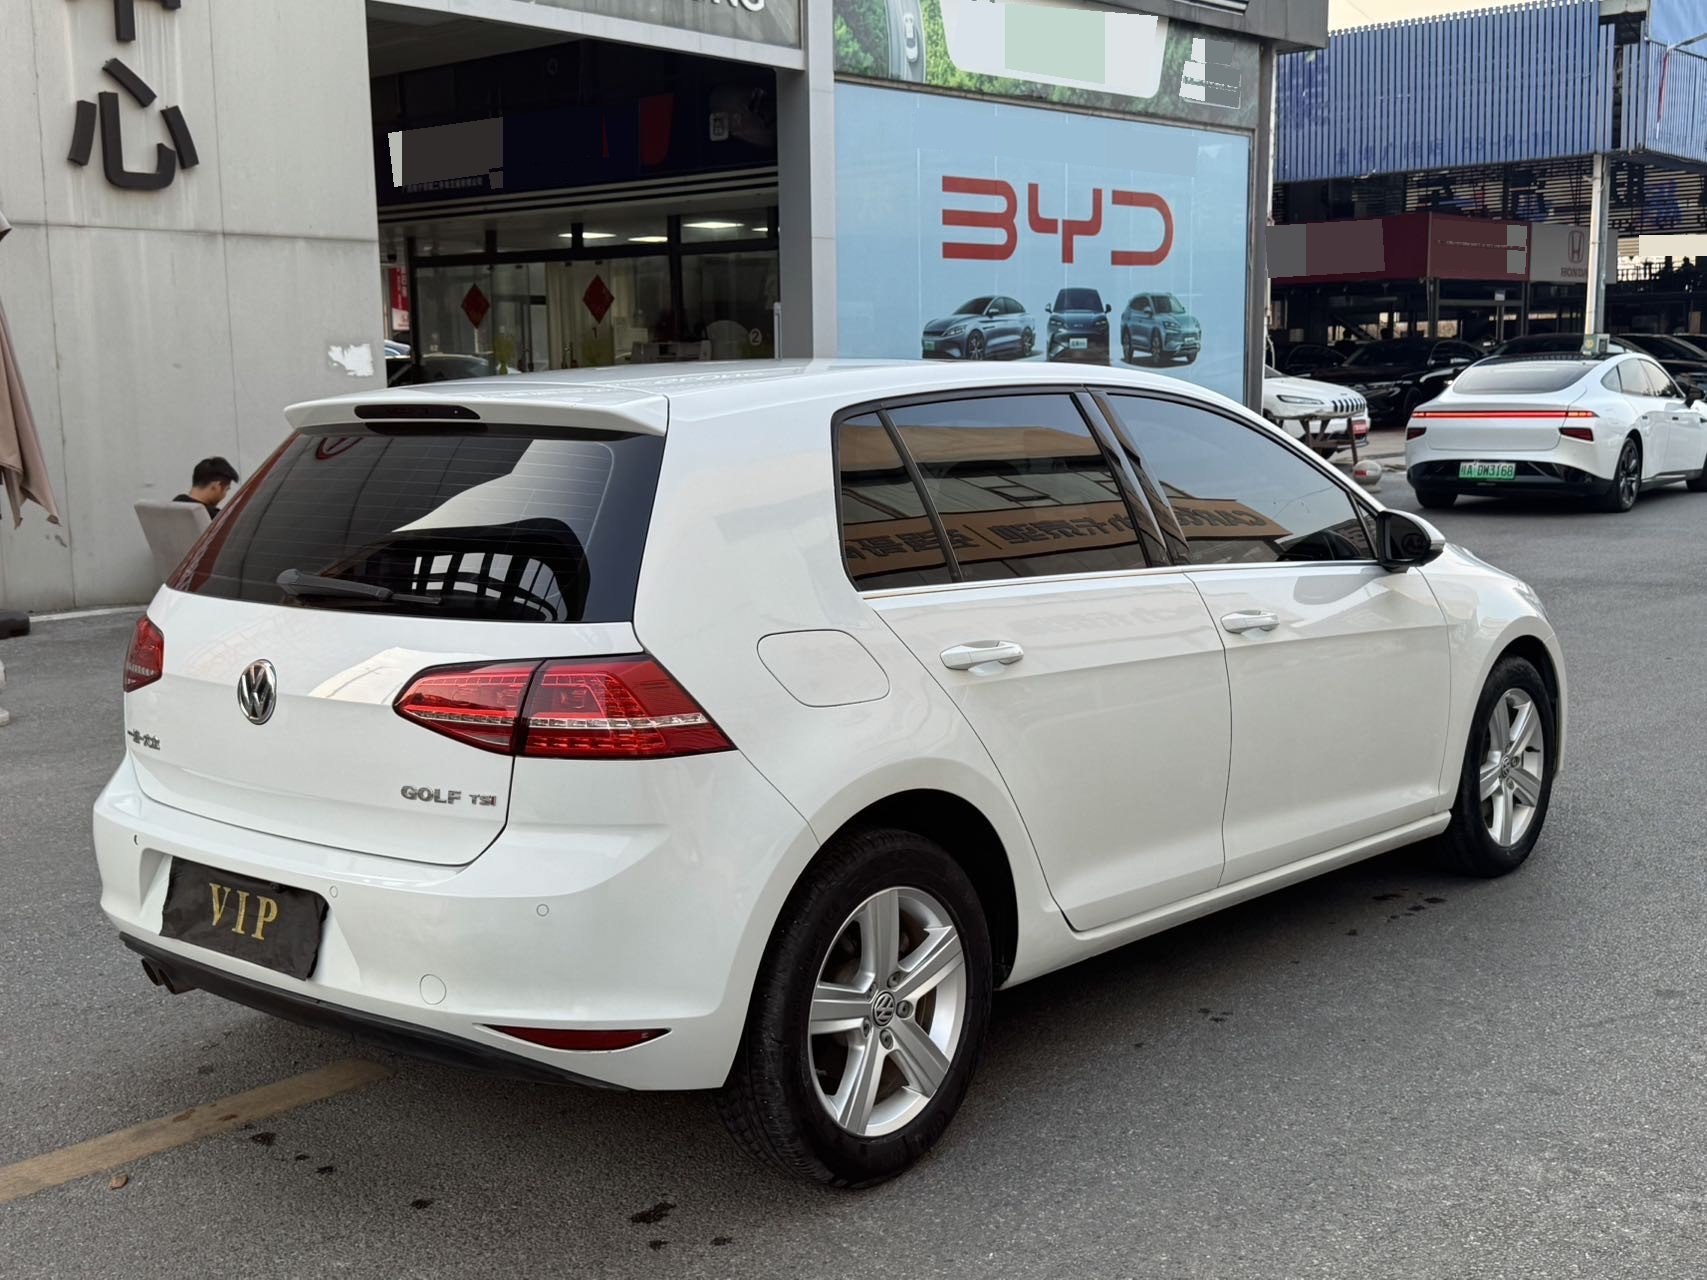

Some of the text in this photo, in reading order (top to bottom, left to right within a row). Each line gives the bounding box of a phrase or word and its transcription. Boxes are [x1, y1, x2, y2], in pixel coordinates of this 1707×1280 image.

[941, 175, 1174, 267] BYD
[1560, 267, 1588, 278] HOND
[400, 785, 497, 807] GOLF TSI
[208, 882, 279, 941] VIP
